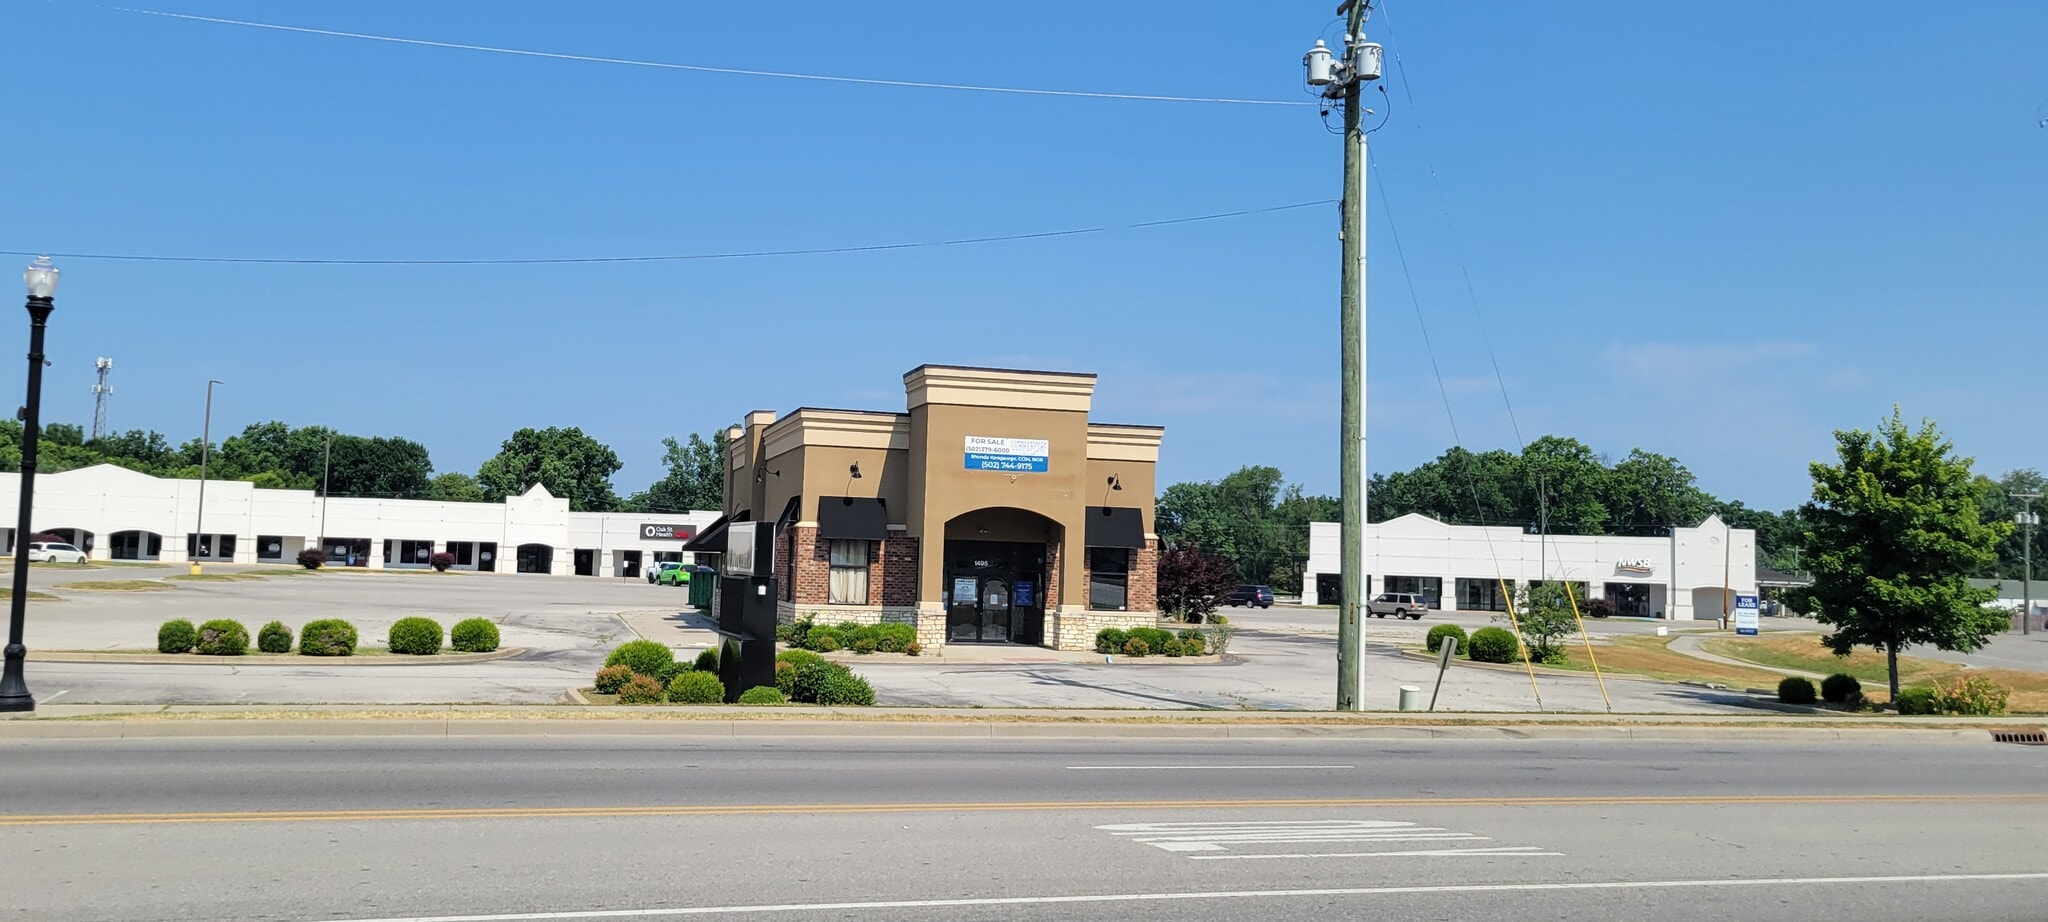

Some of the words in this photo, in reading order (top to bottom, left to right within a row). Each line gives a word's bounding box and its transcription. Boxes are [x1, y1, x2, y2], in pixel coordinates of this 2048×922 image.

[981, 461, 999, 470] (502)
[1001, 461, 1033, 470] 744-9175
[1618, 557, 1651, 567] NWSB
